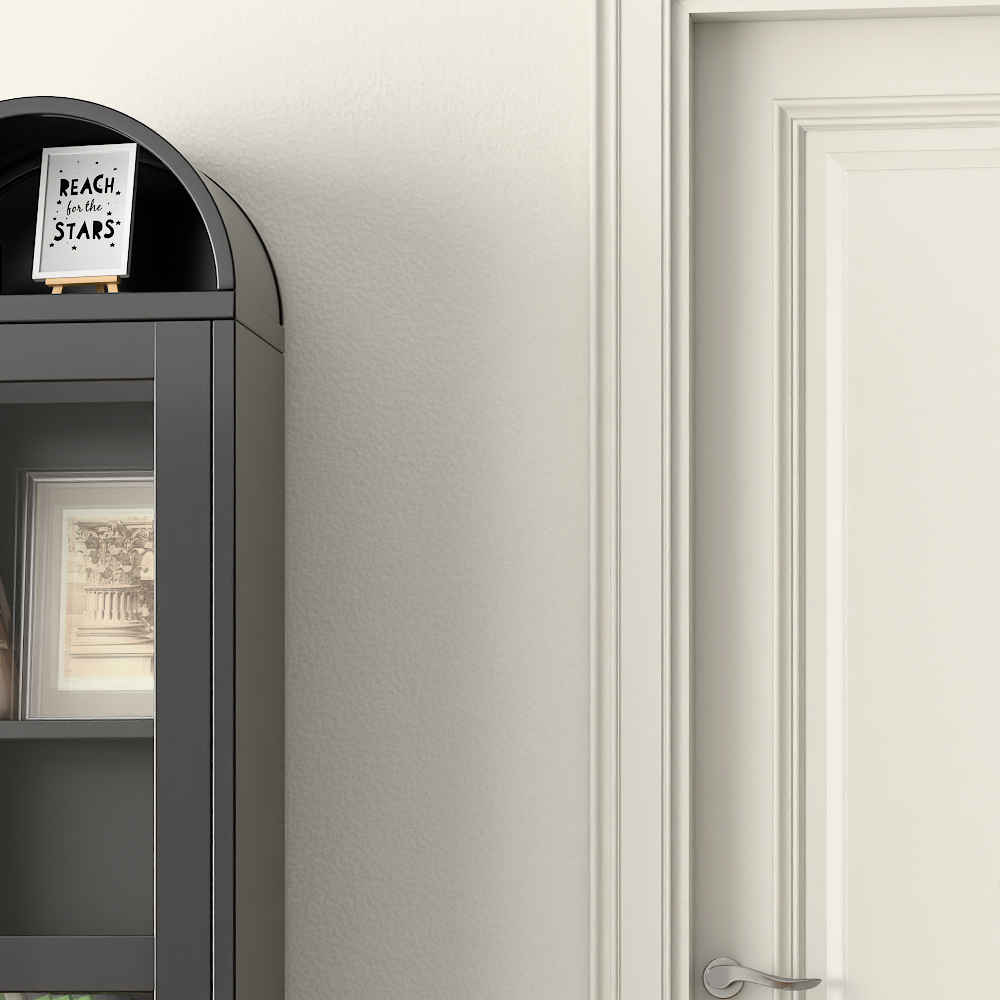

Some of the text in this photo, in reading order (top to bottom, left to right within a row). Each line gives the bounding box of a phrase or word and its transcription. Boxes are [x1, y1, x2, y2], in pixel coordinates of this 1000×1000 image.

[59, 173, 116, 197] REACH
[66, 198, 103, 215] for the
[53, 219, 115, 242] STARS
